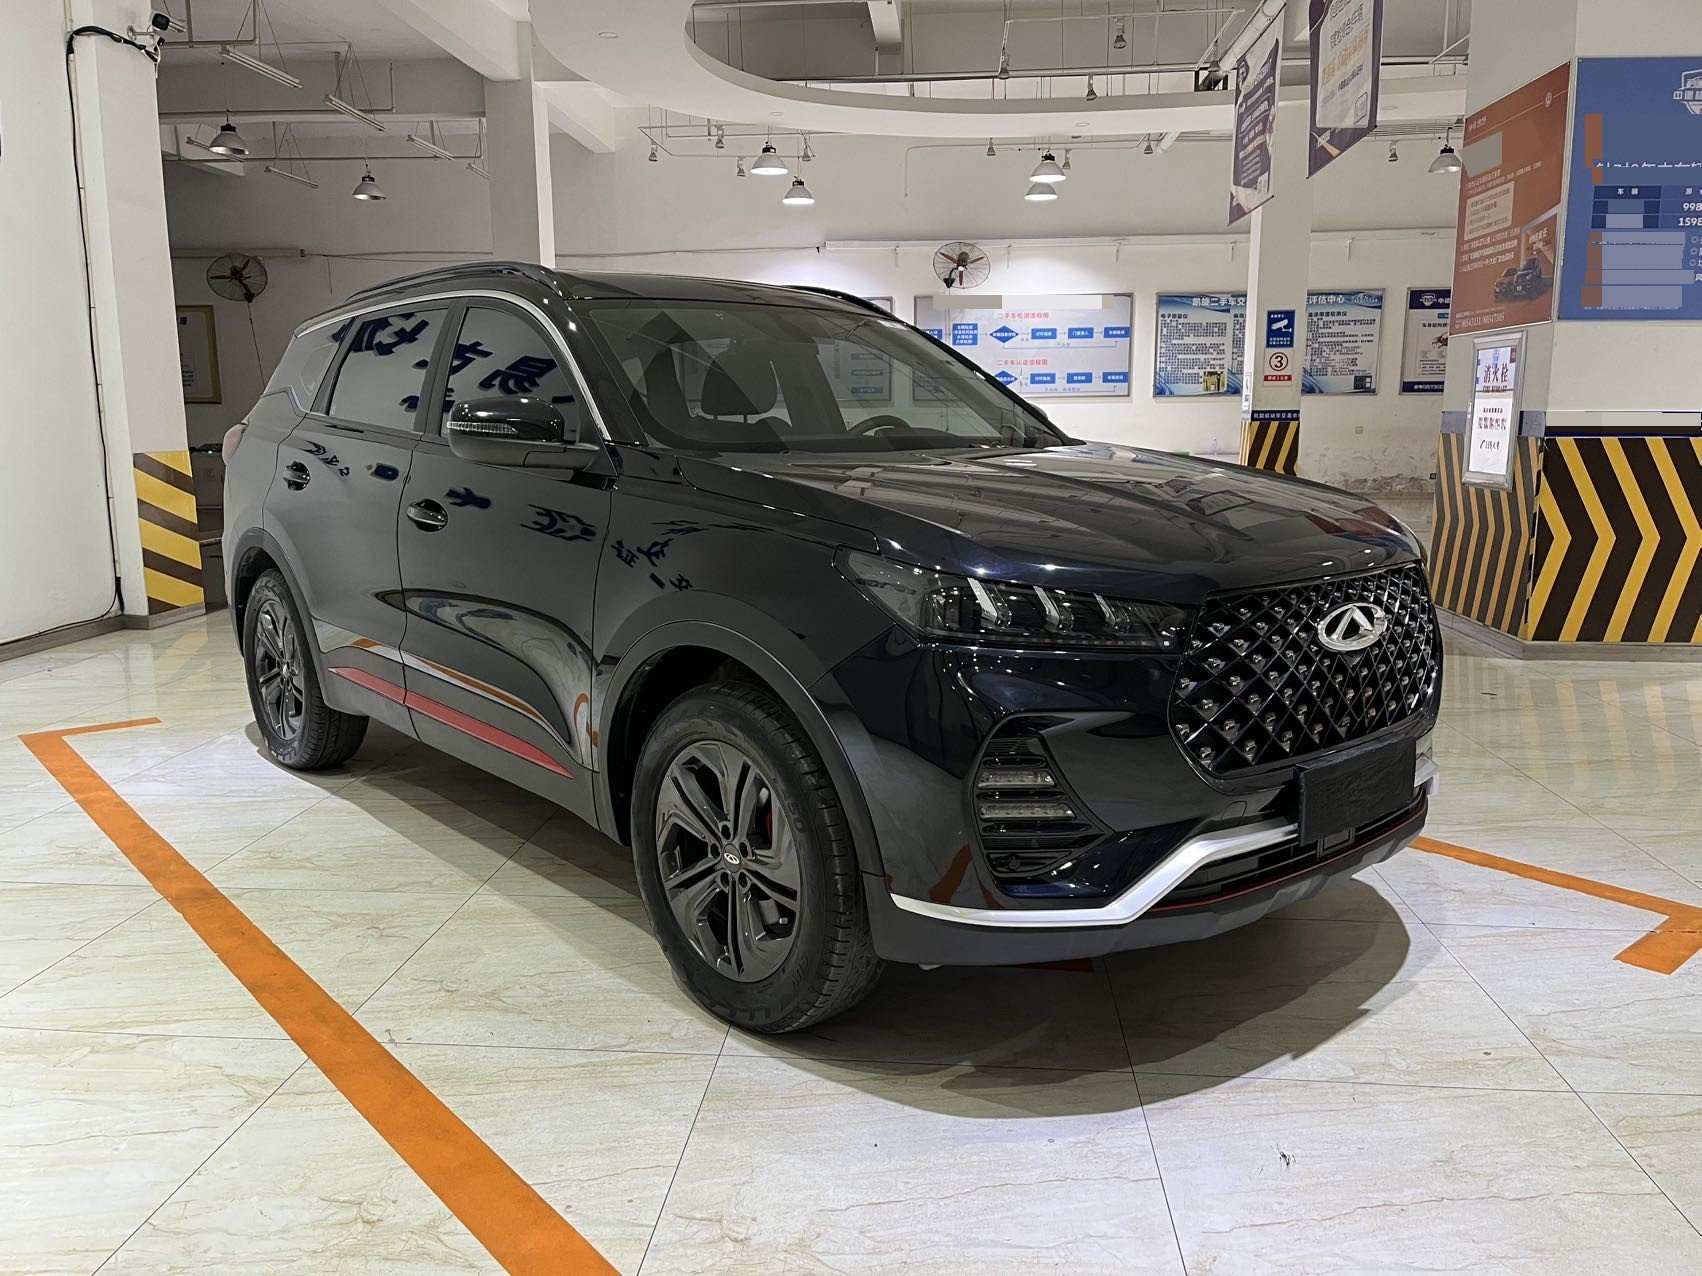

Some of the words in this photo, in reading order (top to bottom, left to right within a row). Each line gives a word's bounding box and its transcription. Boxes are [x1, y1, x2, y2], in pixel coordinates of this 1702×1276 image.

[1273, 355, 1284, 368] 3
[1483, 363, 1509, 383] 消火栓
